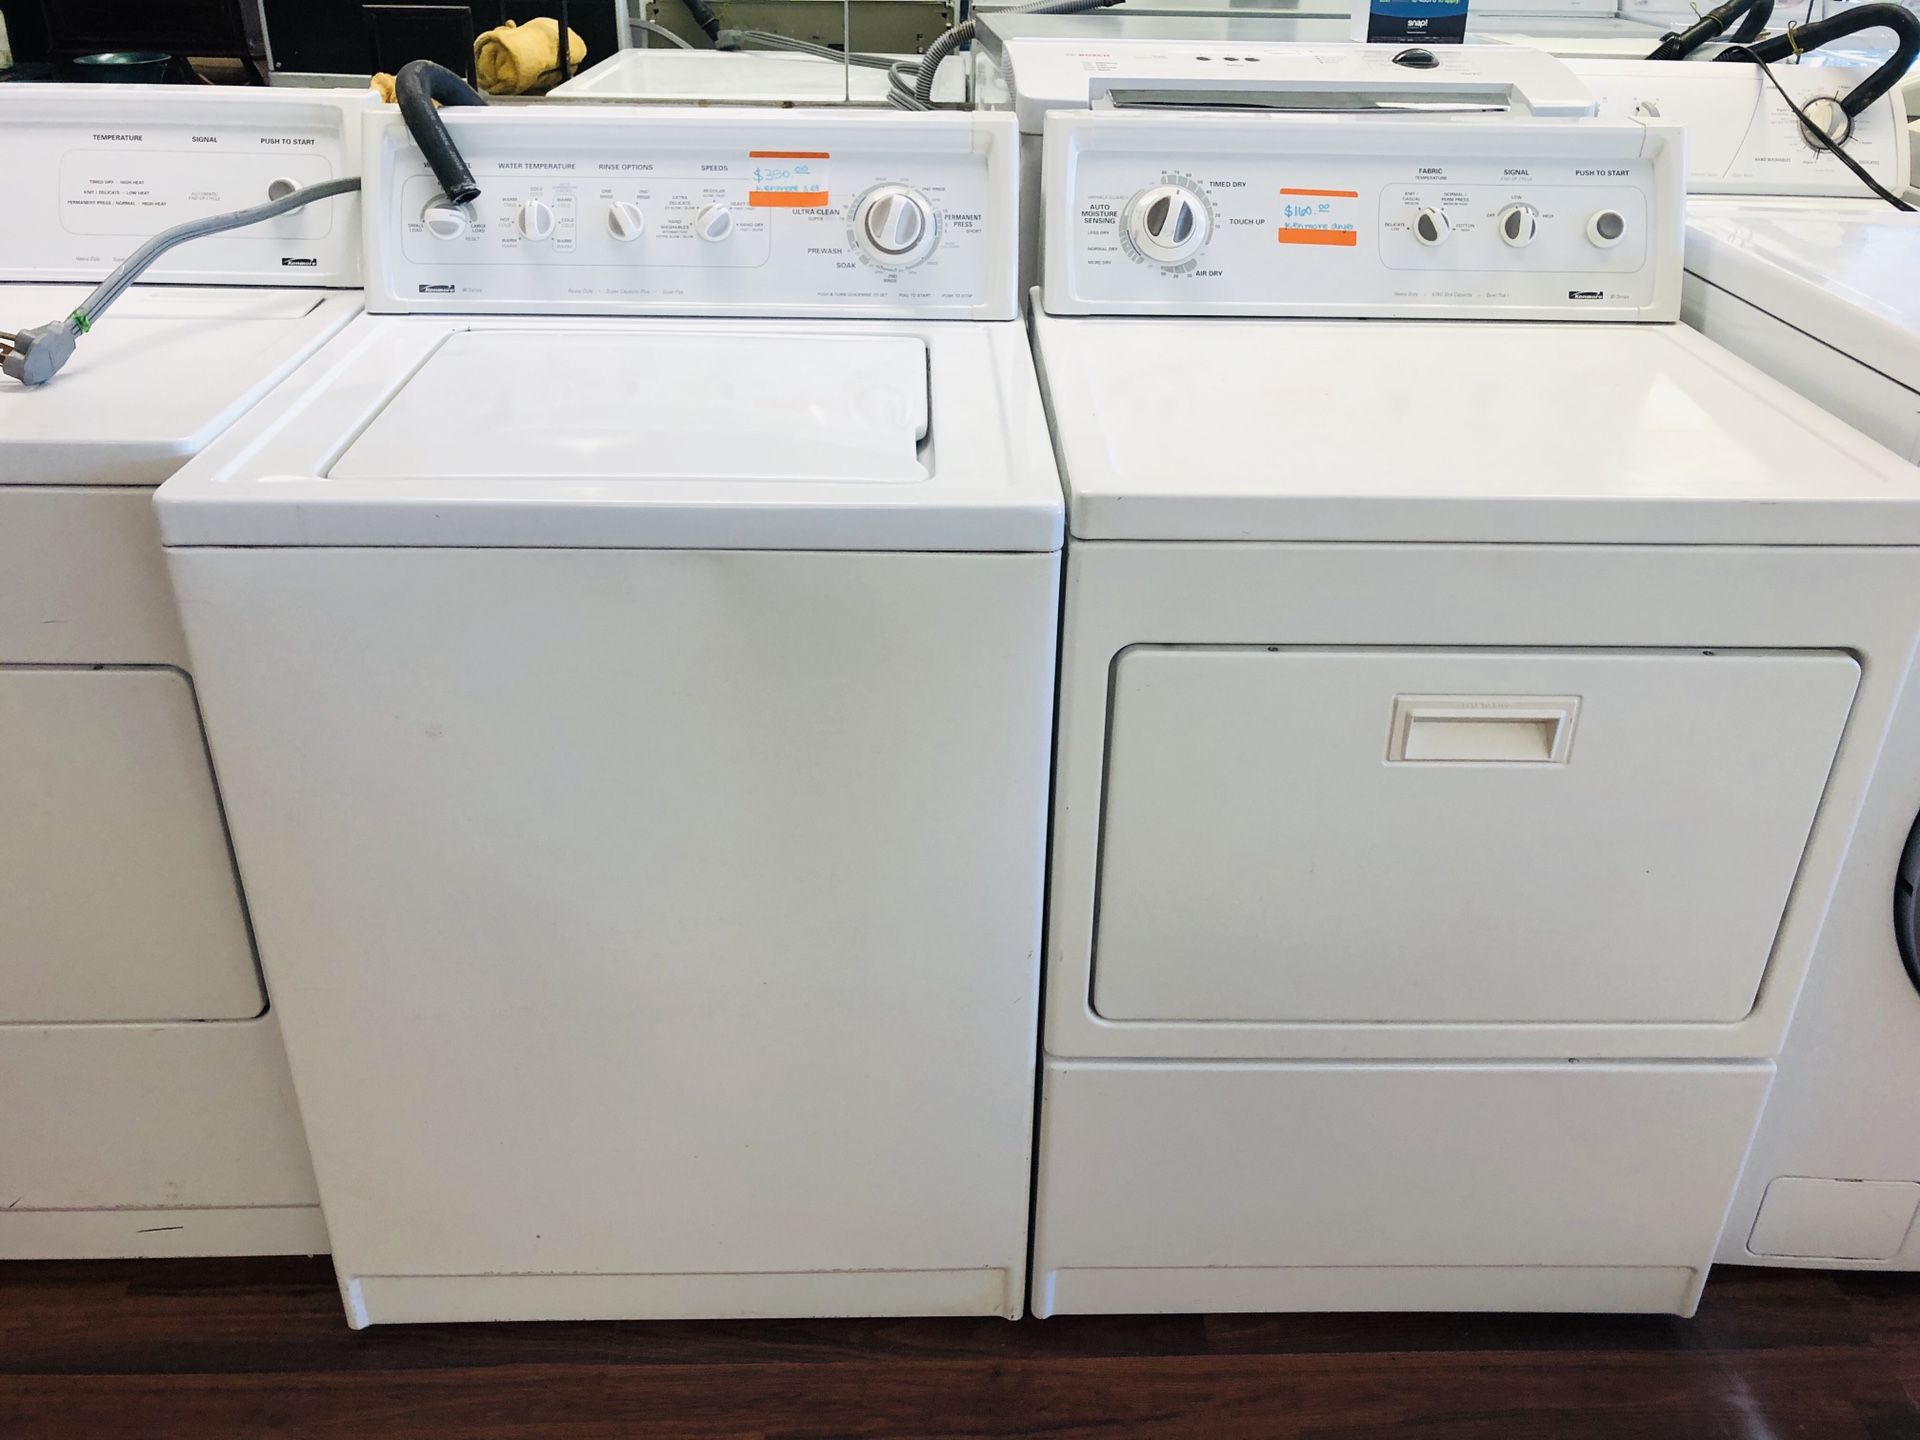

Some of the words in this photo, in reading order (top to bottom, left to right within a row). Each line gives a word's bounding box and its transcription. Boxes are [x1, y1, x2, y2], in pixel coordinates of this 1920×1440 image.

[1407, 19, 1428, 29] snap!
[92, 134, 143, 142] TEMPERATURE
[191, 135, 218, 144] SIGNAL
[260, 137, 280, 146] PUSH
[281, 137, 292, 146] TO
[292, 138, 315, 146] START
[621, 163, 654, 171] OPTIONS
[700, 164, 729, 172] SPEEDS
[792, 208, 815, 216] ULTRA
[1083, 217, 1116, 225] SENSING
